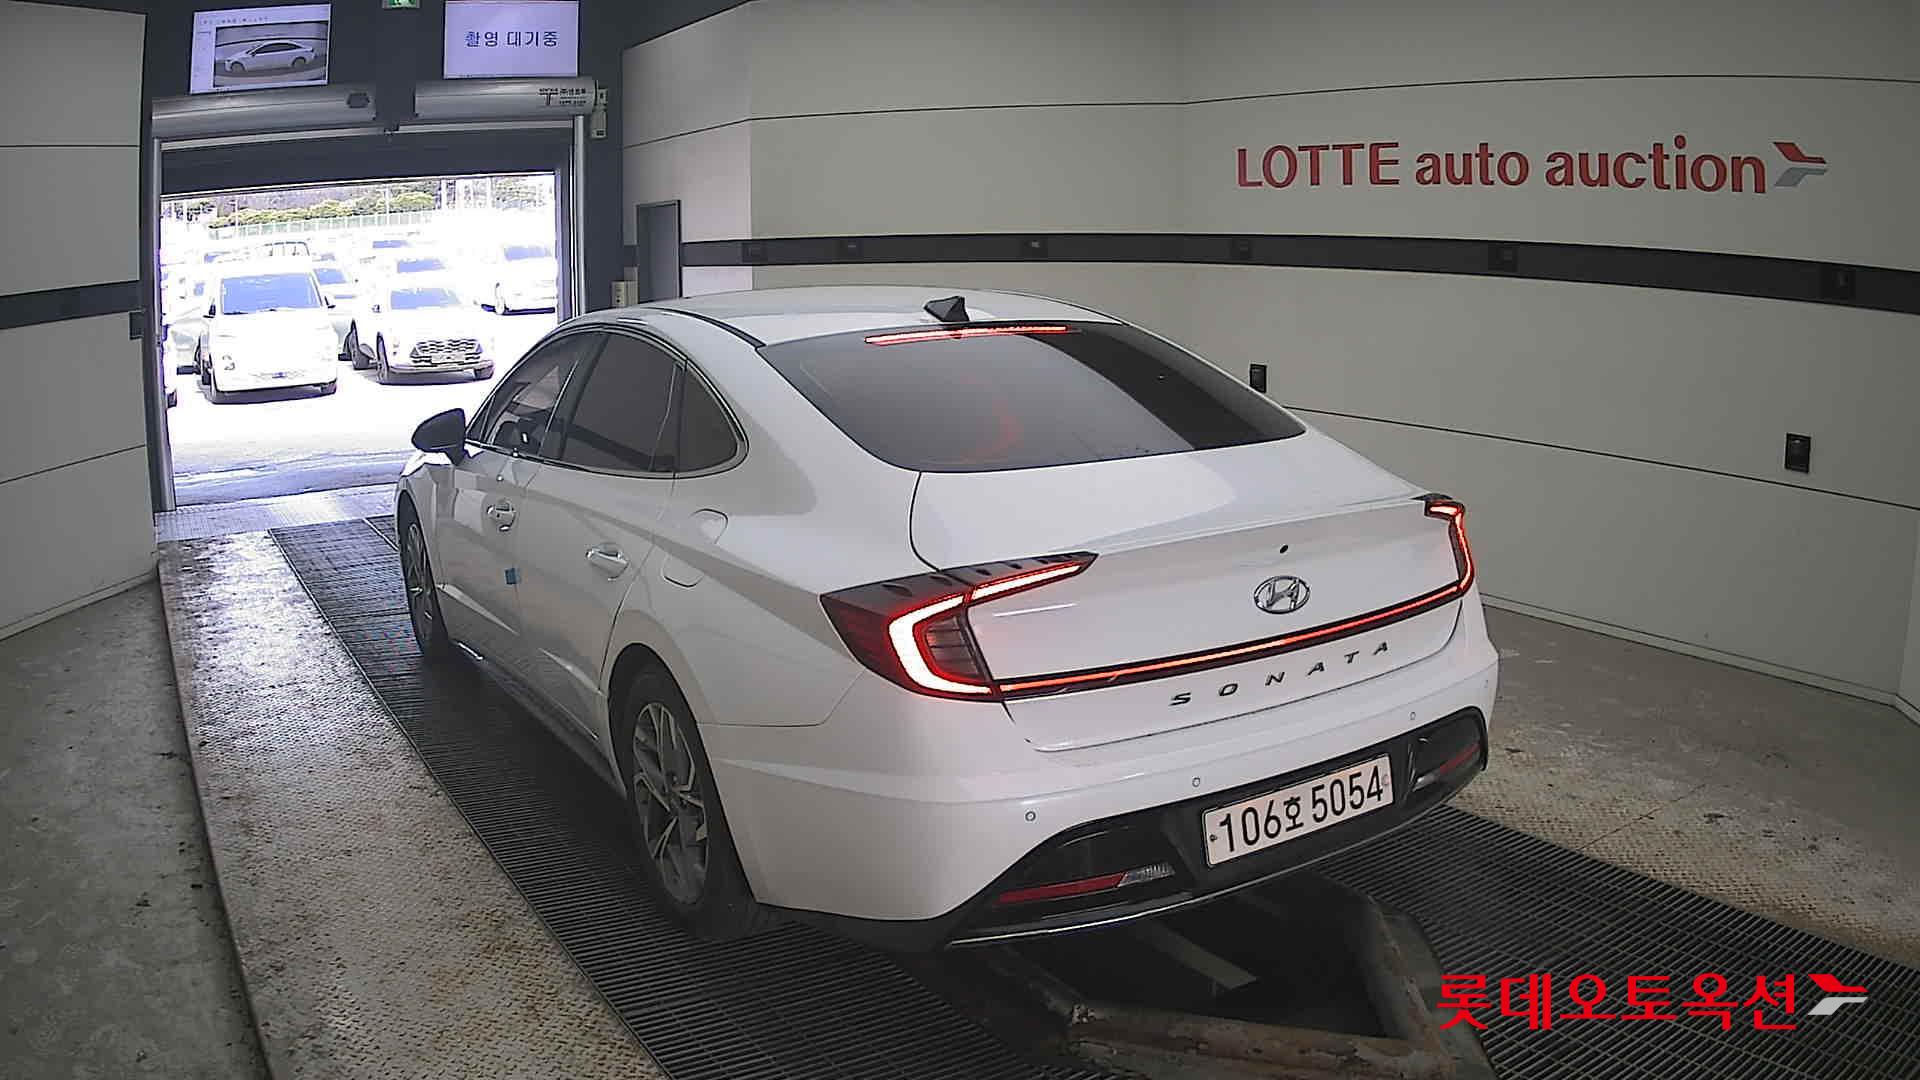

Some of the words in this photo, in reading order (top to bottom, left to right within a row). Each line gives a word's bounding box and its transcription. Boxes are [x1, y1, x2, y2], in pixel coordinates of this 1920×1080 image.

[507, 30, 557, 47] 대기중
[1236, 142, 1400, 188] LOTTE
[1415, 142, 1529, 186] auto
[1545, 134, 1766, 193] auction
[1168, 641, 1388, 706] SONATA
